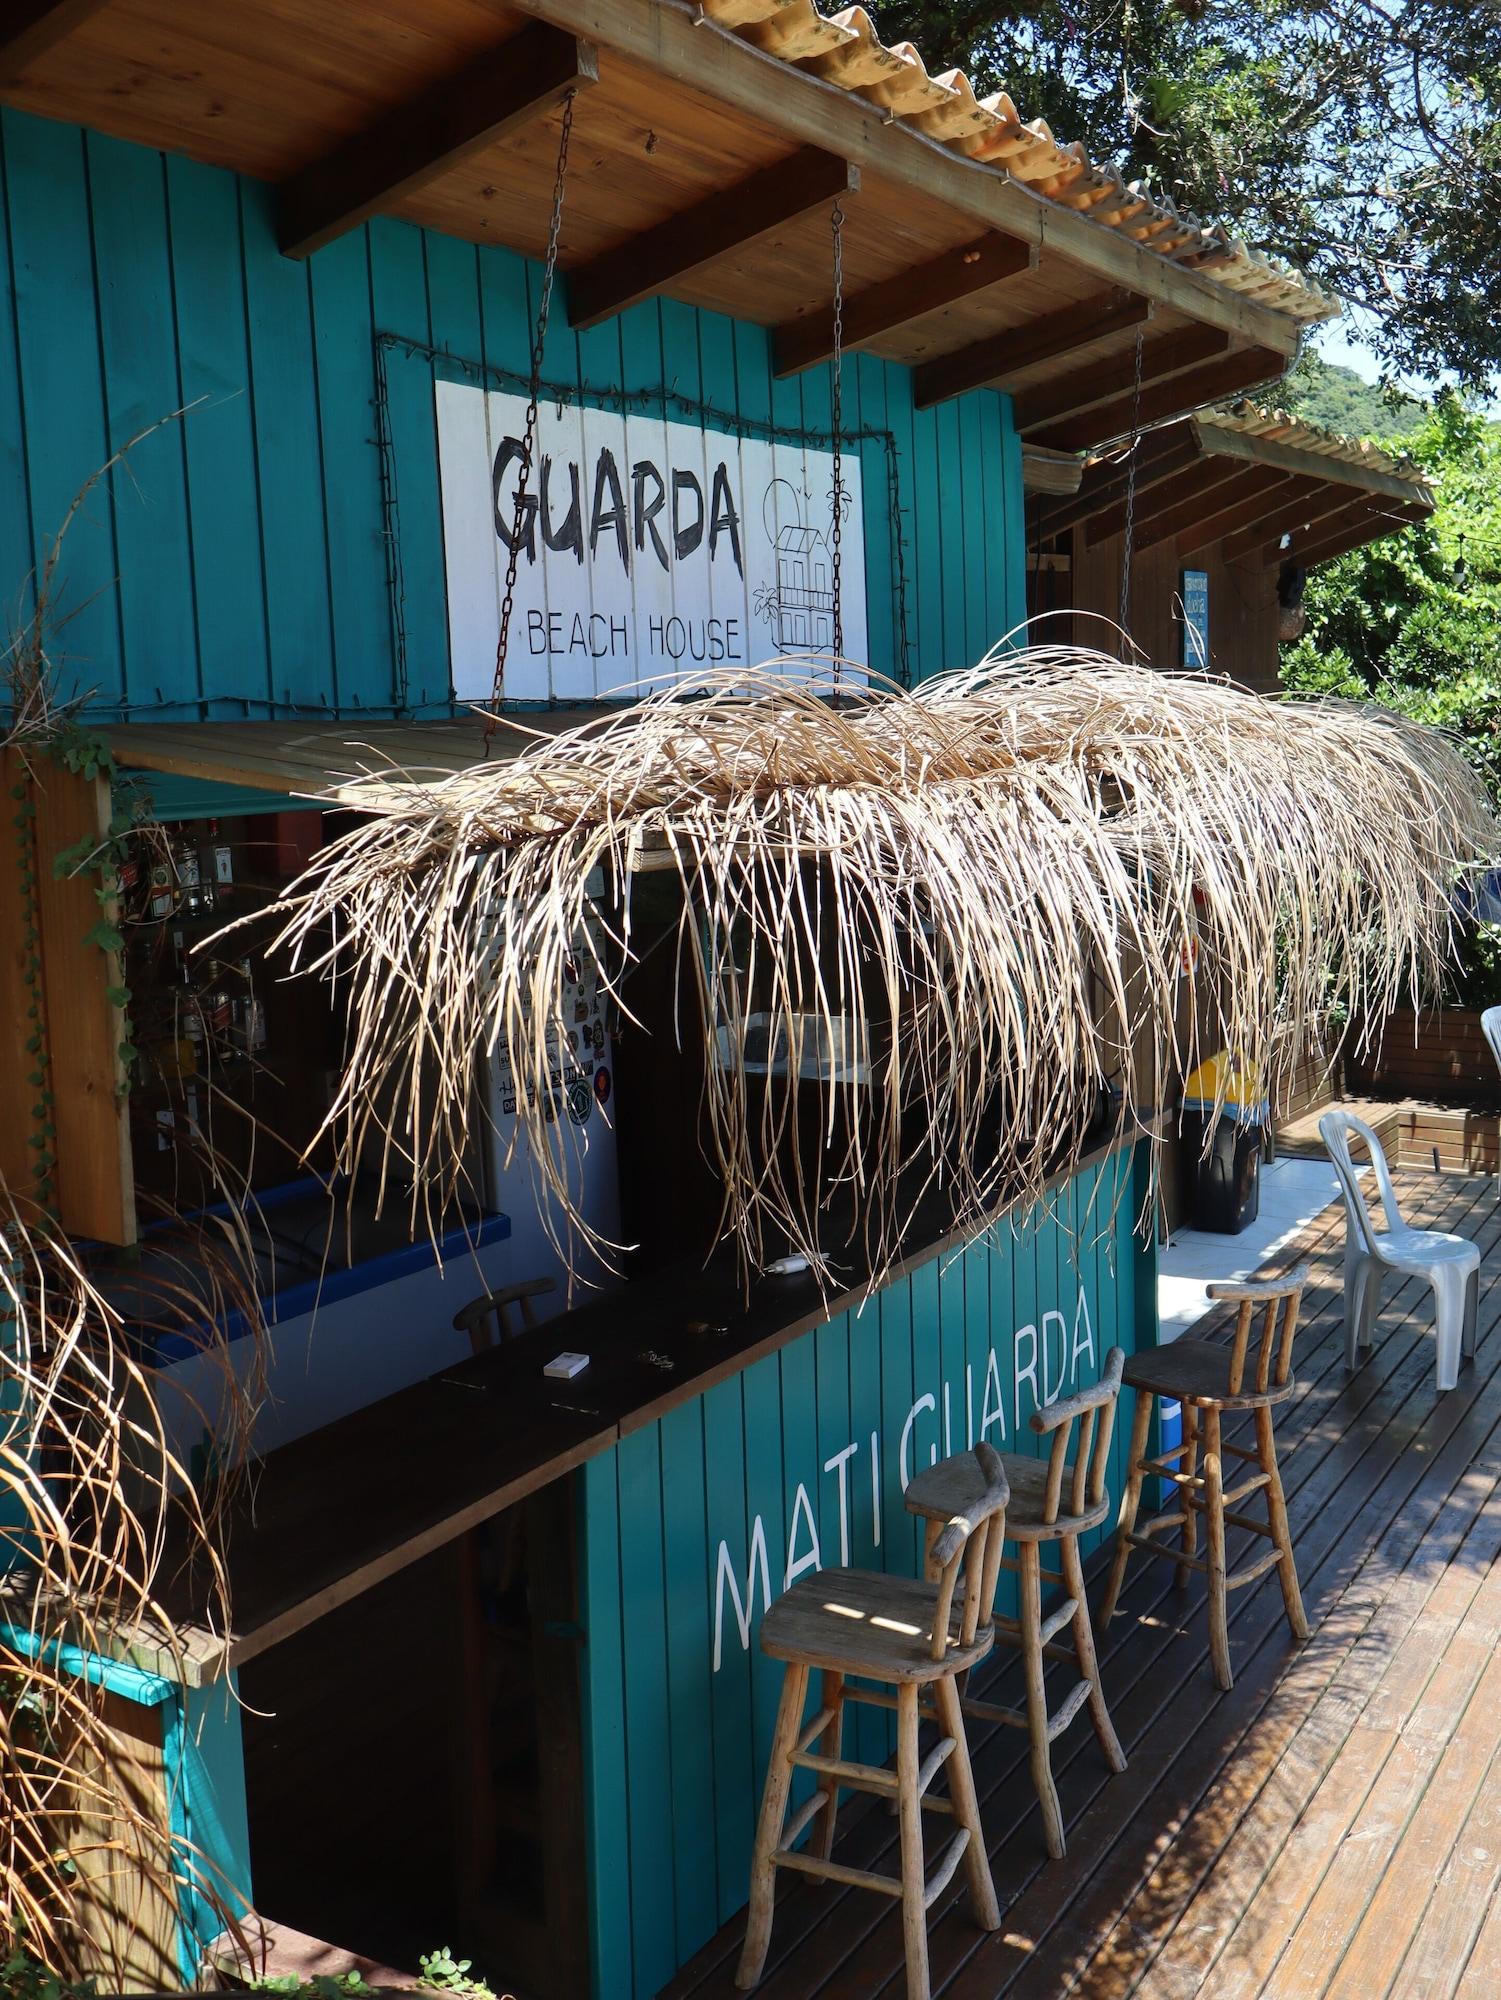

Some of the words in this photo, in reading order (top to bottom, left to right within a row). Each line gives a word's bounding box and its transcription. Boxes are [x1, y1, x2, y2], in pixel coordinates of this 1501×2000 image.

[493, 435, 744, 582] GUARDA
[527, 609, 628, 658] BEACH
[648, 613, 742, 661] HOUSE
